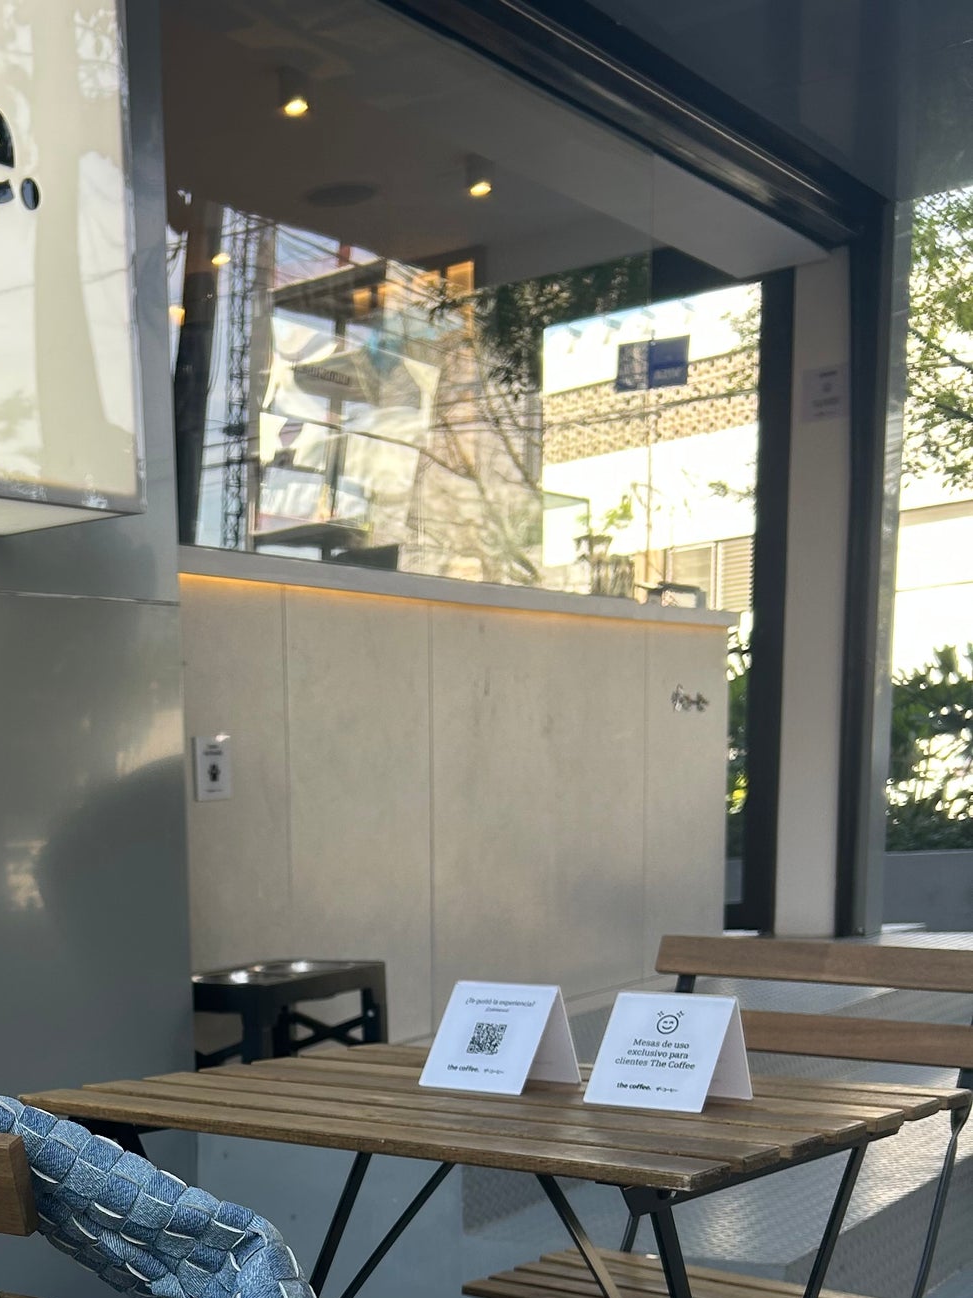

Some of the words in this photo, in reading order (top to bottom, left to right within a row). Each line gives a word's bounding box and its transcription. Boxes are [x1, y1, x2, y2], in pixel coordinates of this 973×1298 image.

[633, 1038, 660, 1047] Mesas
[661, 1040, 672, 1048] de
[627, 1048, 668, 1058] exclusivo
[668, 1051, 689, 1060] para
[615, 1056, 648, 1066] clientes
[650, 1059, 667, 1068] The
[668, 1060, 696, 1070] Coffee
[616, 1081, 628, 1089] the
